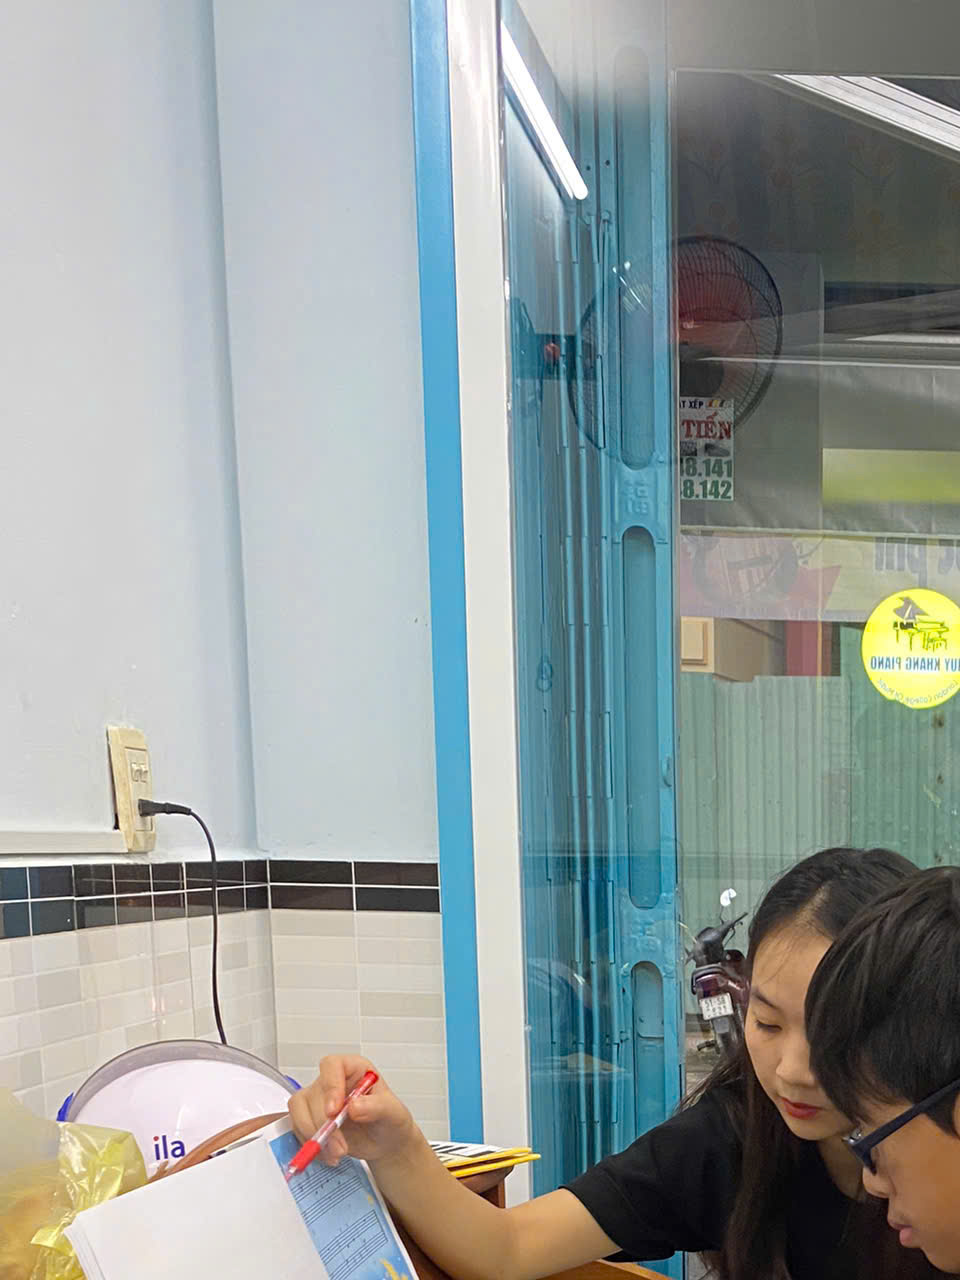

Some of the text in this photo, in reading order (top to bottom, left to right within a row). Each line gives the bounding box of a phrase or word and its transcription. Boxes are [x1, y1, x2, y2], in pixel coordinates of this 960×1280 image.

[682, 412, 732, 440] TIẾN
[680, 479, 732, 499] 8.142
[153, 1135, 186, 1162] ila
